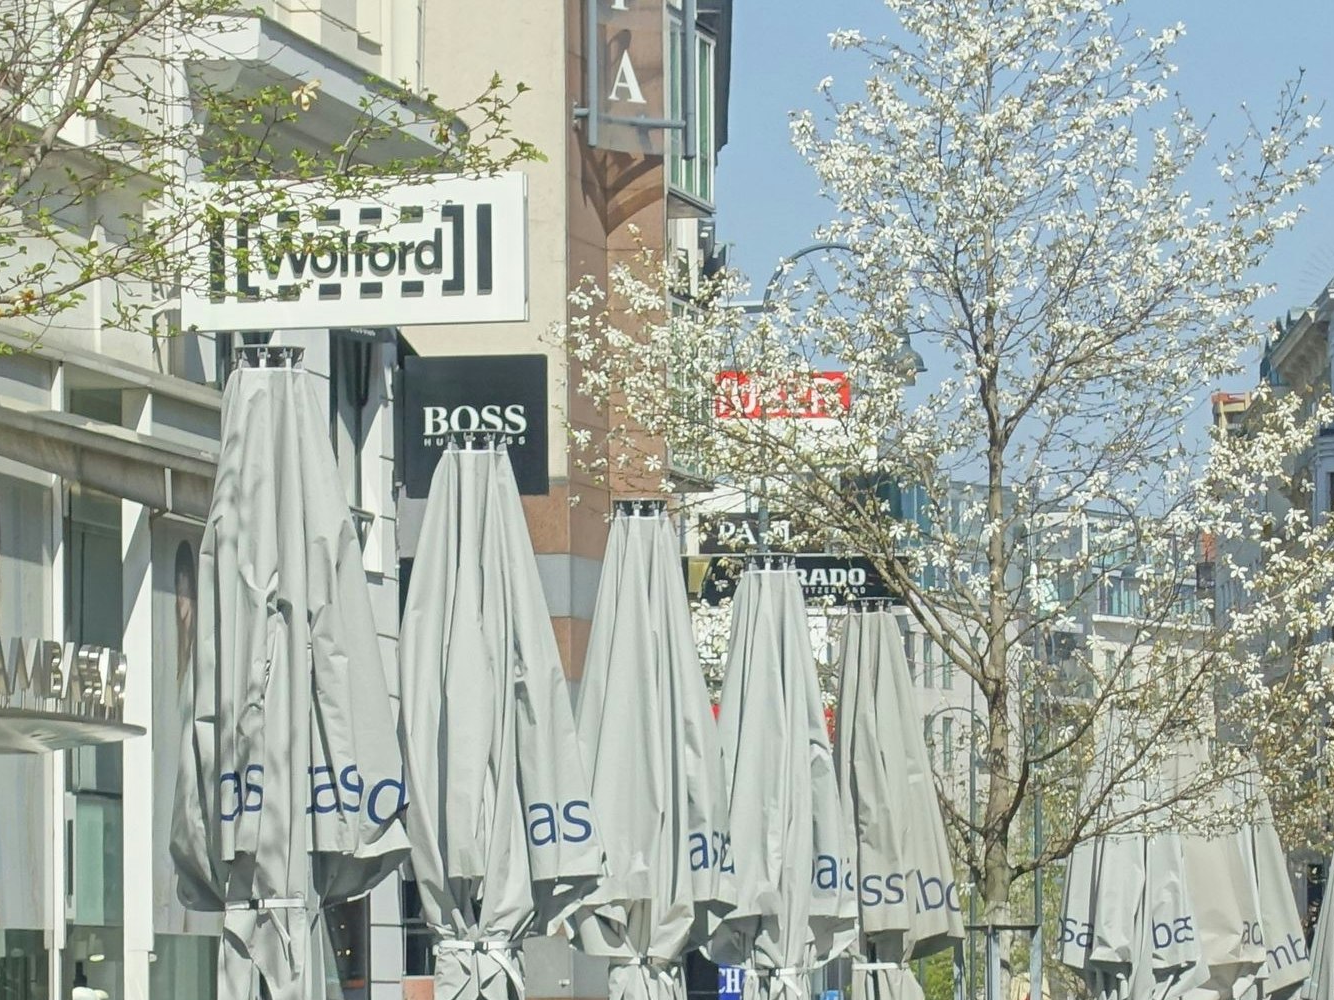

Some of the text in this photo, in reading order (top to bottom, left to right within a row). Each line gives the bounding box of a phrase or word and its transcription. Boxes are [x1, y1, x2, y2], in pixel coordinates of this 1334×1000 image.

[262, 227, 443, 278] Wolford
[423, 404, 528, 436] BOSS
[793, 567, 866, 587] RADO
[528, 799, 593, 848] as
